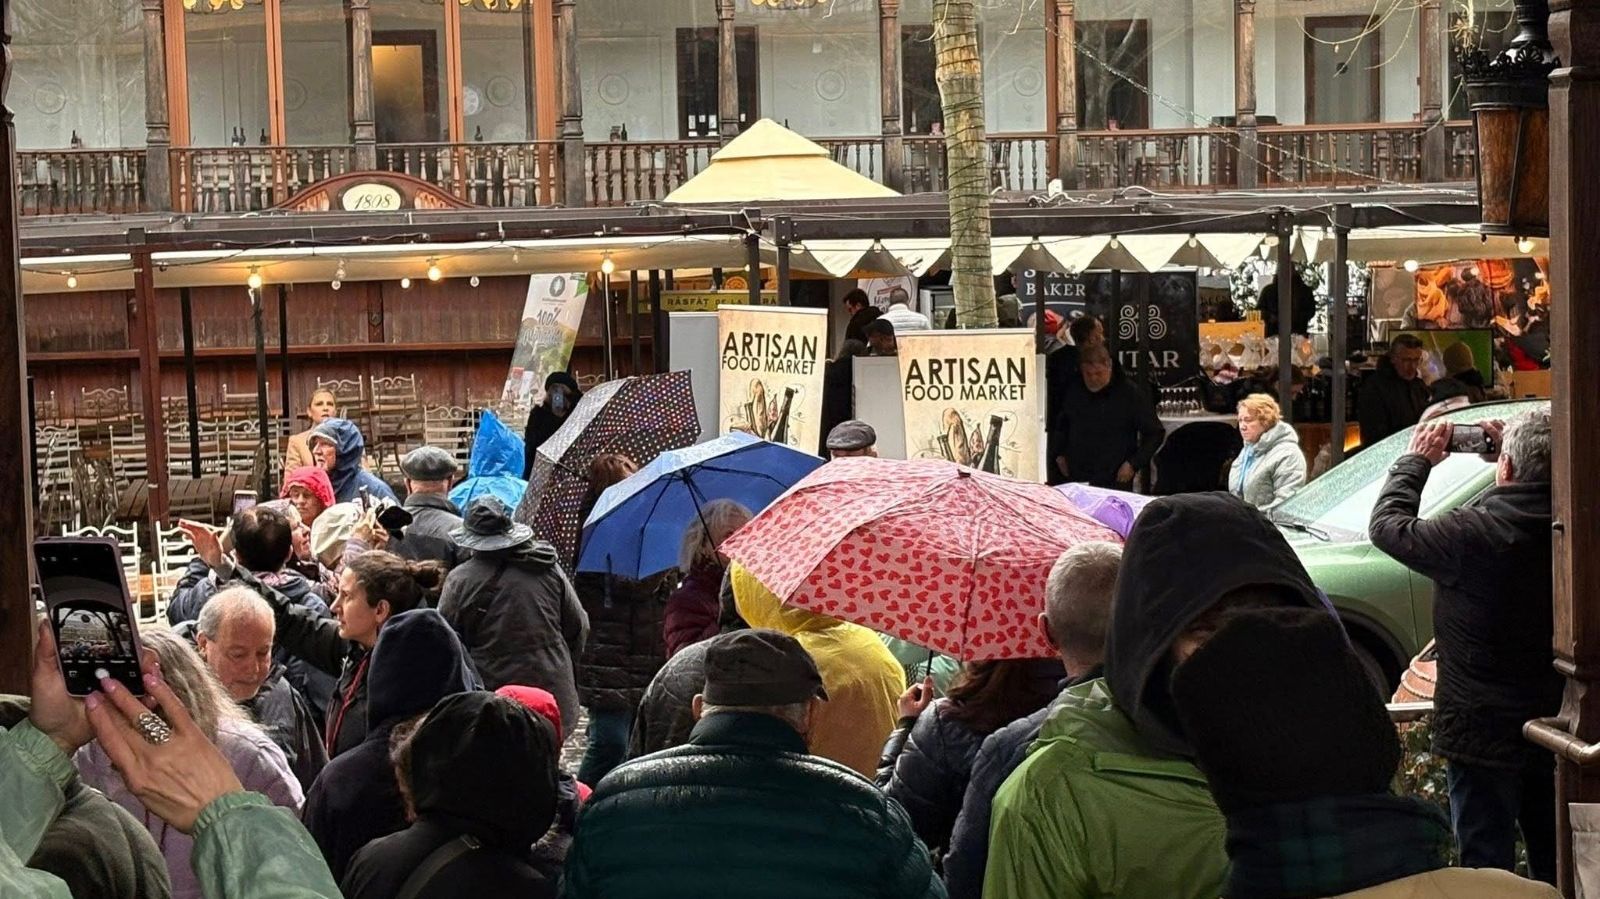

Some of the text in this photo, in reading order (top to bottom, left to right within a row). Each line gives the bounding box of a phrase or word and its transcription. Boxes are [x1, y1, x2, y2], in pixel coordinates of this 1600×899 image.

[354, 193, 393, 210] 1808
[723, 331, 818, 361] ARTISAN
[721, 355, 817, 375] FOOD MARKET
[905, 357, 1027, 385] ARTISAN
[904, 384, 1027, 401] FOOD MARKET
